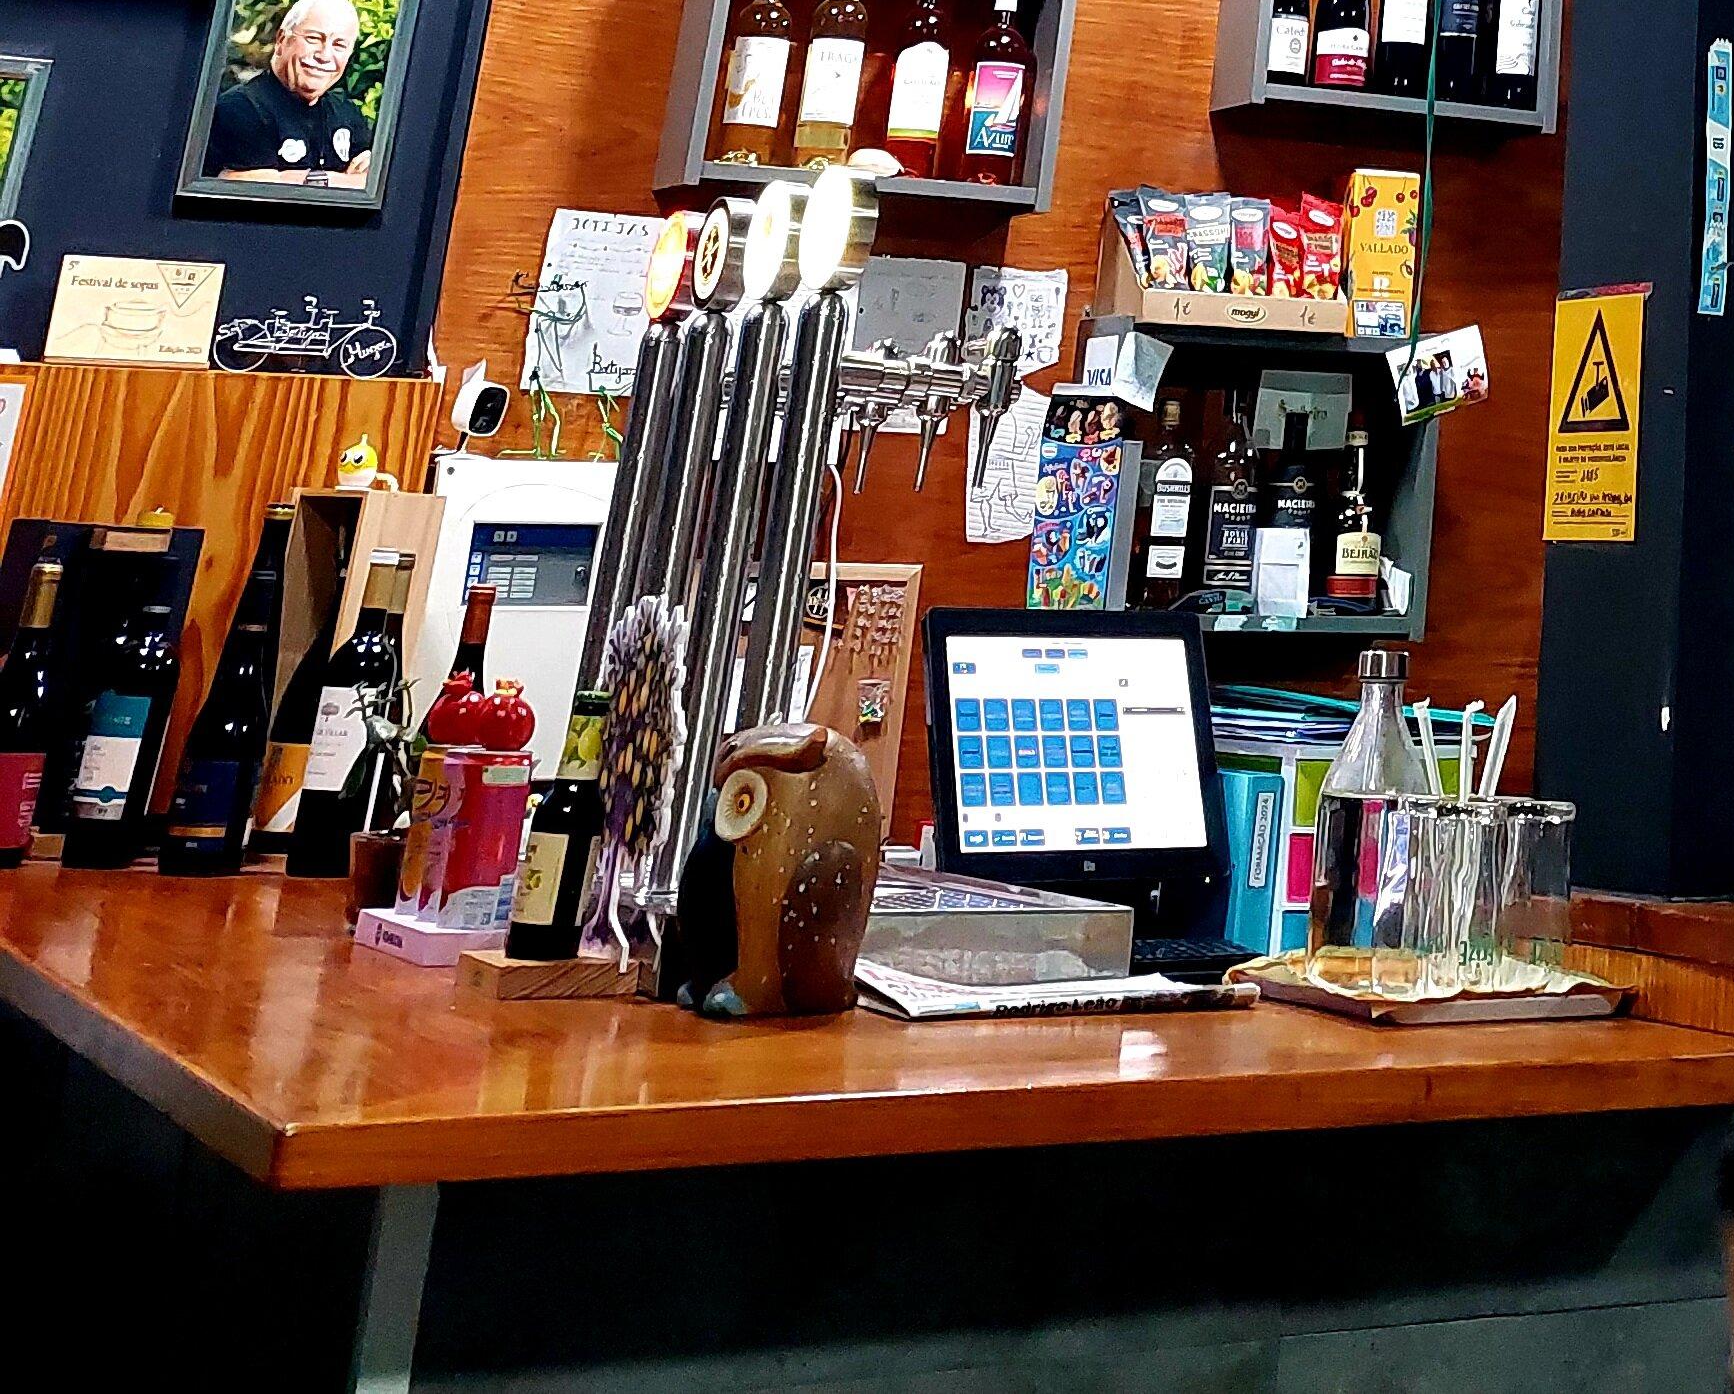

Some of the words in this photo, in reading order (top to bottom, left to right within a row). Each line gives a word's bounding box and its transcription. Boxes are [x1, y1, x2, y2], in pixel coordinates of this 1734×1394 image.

[1360, 243, 1409, 254] VALLADO
[71, 275, 112, 288] Festival
[115, 278, 127, 288] de
[130, 280, 159, 292] sopas
[1087, 369, 1112, 386] VISA
